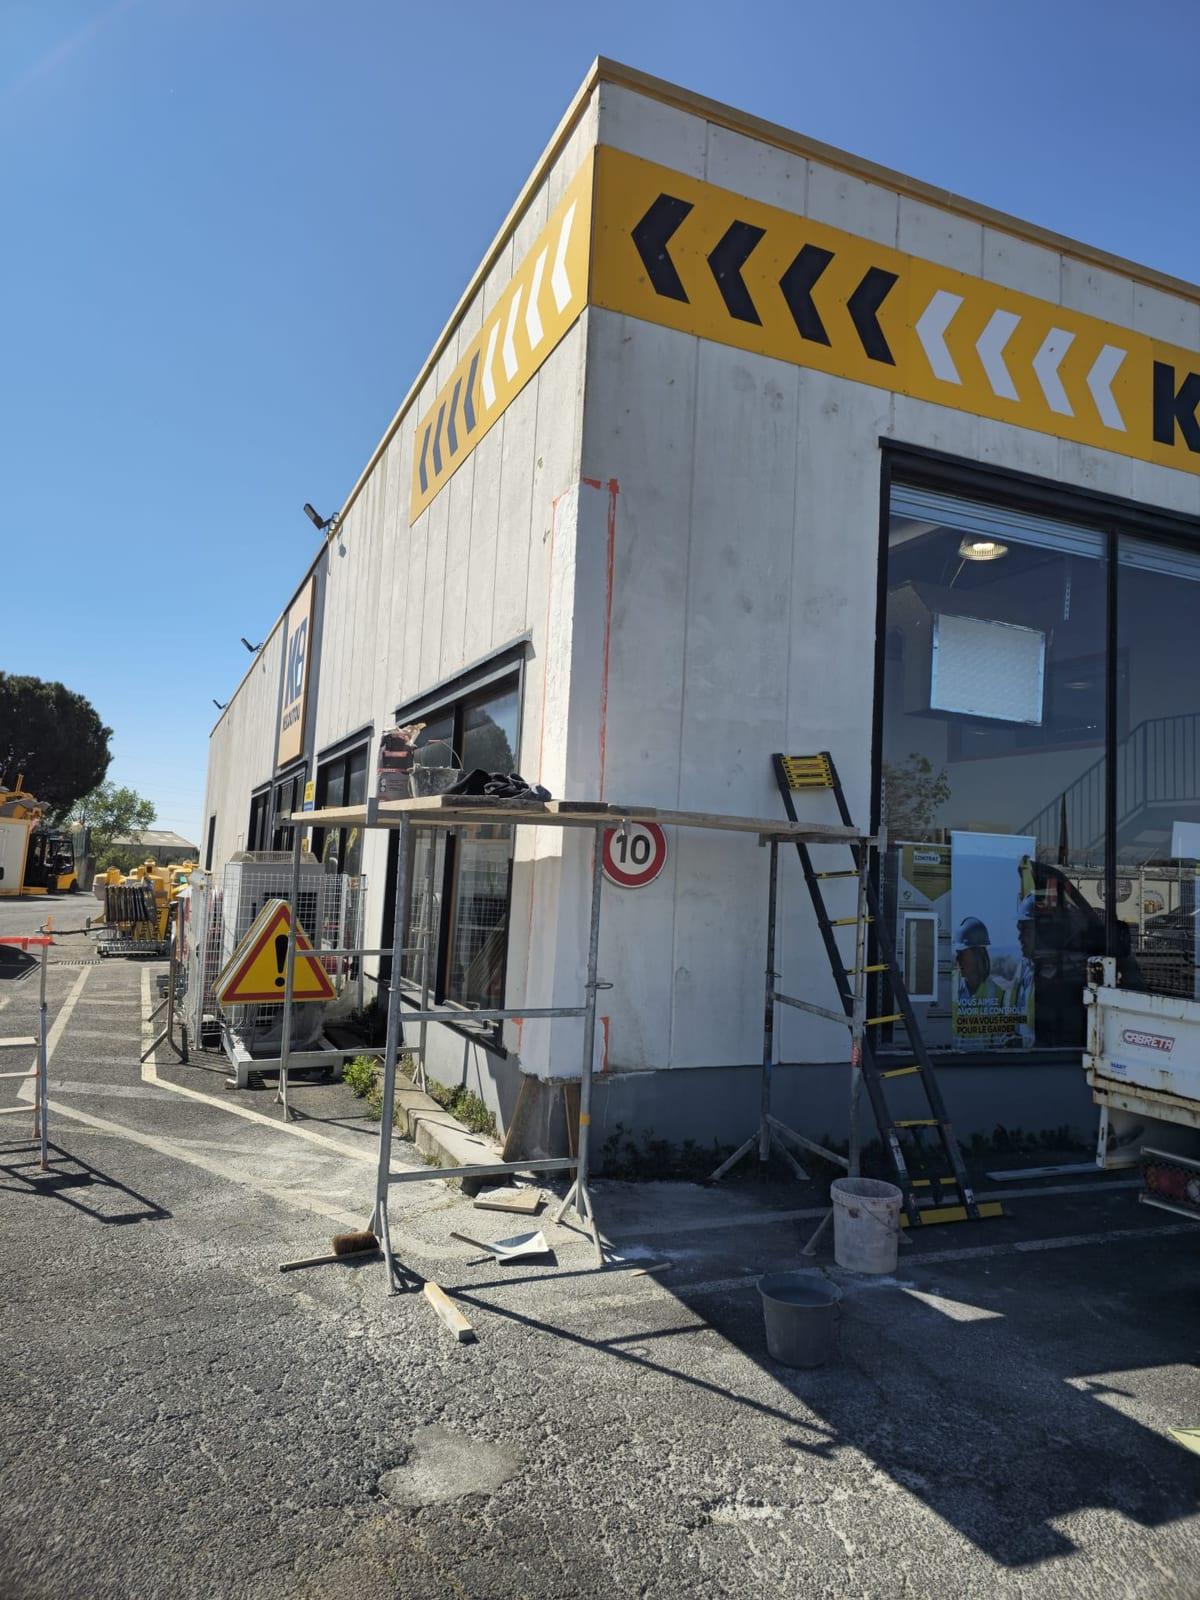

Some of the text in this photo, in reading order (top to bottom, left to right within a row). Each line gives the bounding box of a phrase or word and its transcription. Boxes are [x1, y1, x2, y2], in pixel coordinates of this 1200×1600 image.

[615, 833, 651, 865] 10
[957, 998, 977, 1007] VOUS
[957, 1007, 979, 1016] AVOIR
[980, 1007, 988, 1015] LE
[957, 1015, 1027, 1025] ON VA VOUS FORMER
[957, 1025, 979, 1033] POUR
[979, 1025, 987, 1033] LE
